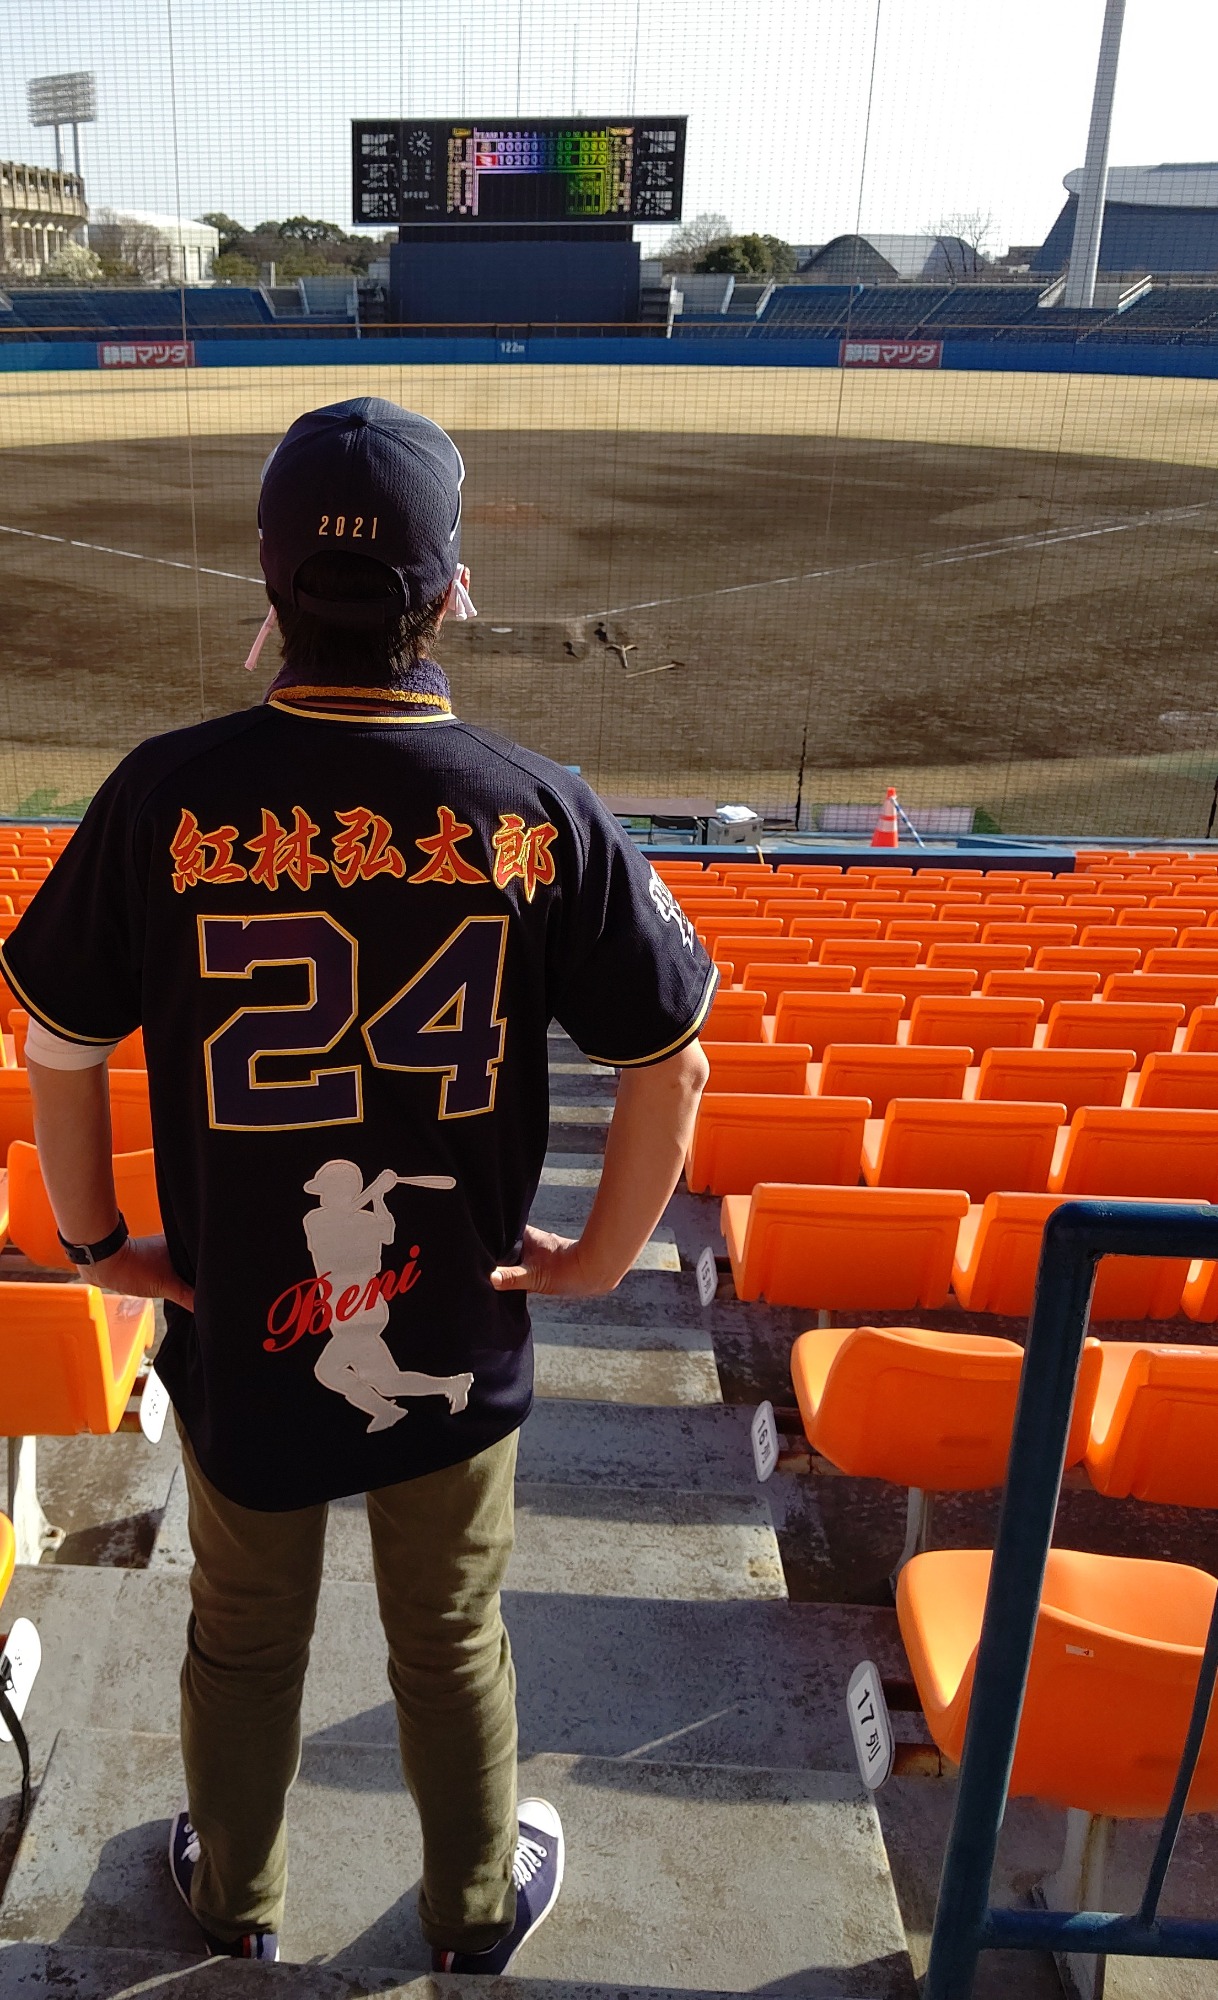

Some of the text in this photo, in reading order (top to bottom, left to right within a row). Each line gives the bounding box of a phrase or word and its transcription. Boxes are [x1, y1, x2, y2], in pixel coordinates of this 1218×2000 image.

[103, 345, 189, 365] 静岡マツダ
[500, 341, 525, 353] 122m
[845, 343, 937, 364] 静岡マツダ
[318, 515, 378, 539] 2021
[169, 805, 558, 904] 紅林弘太郎
[197, 911, 509, 1132] 24
[262, 1244, 422, 1352] Beni
[857, 1688, 882, 1764] 17列
